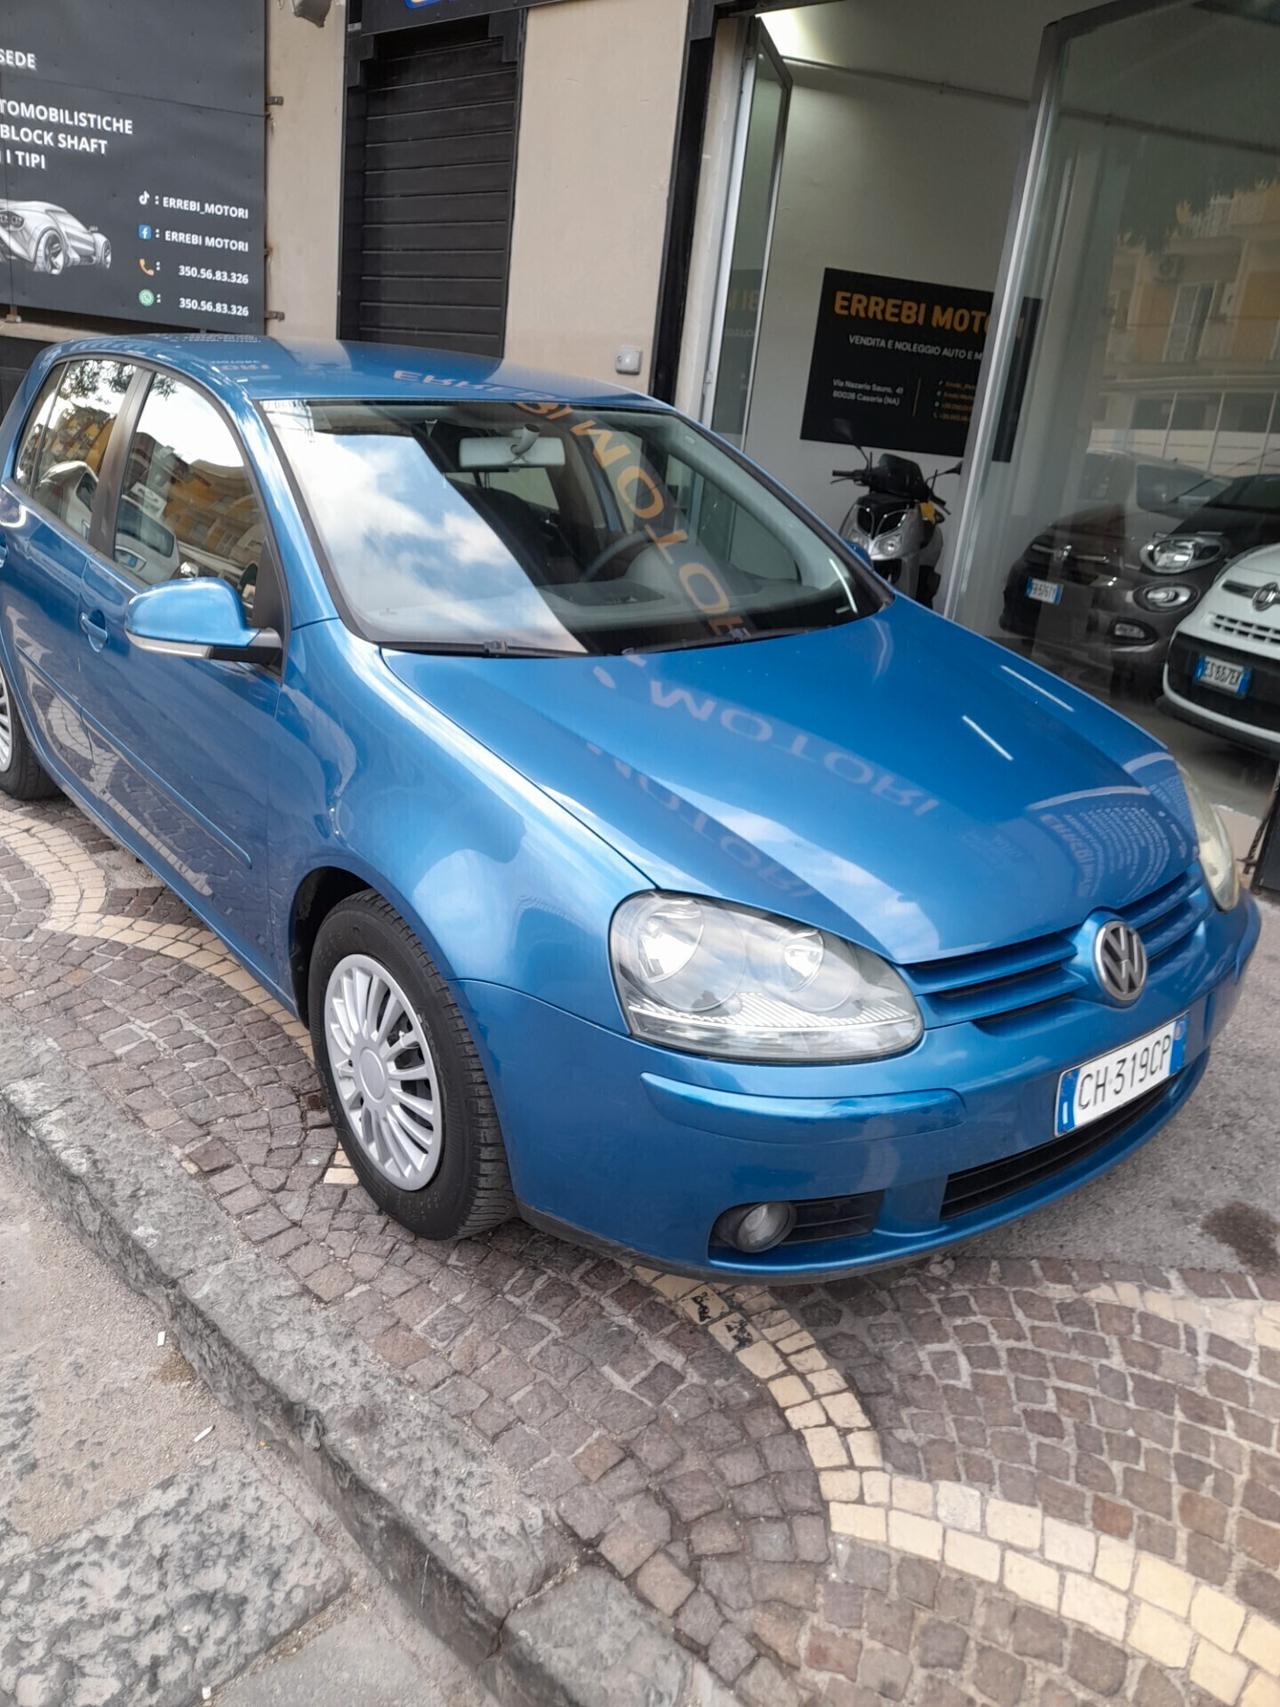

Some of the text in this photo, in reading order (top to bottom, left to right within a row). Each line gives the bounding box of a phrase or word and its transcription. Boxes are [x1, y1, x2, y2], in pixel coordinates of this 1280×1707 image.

[0, 48, 36, 69] SEDE
[0, 123, 107, 155] BLOCK SHAFT
[14, 150, 46, 169] TIPI
[162, 196, 249, 219] ERREBI_MOTORI
[165, 230, 202, 246] ERREBI
[205, 236, 249, 252] MOTORI
[178, 265, 249, 284] 350.56.83.326
[179, 297, 249, 316] 350.56.83.326
[834, 290, 927, 326] ERREBI
[849, 334, 886, 348] VENDITA
[894, 340, 941, 355] NOLEGGIO
[942, 346, 966, 359] AUTO
